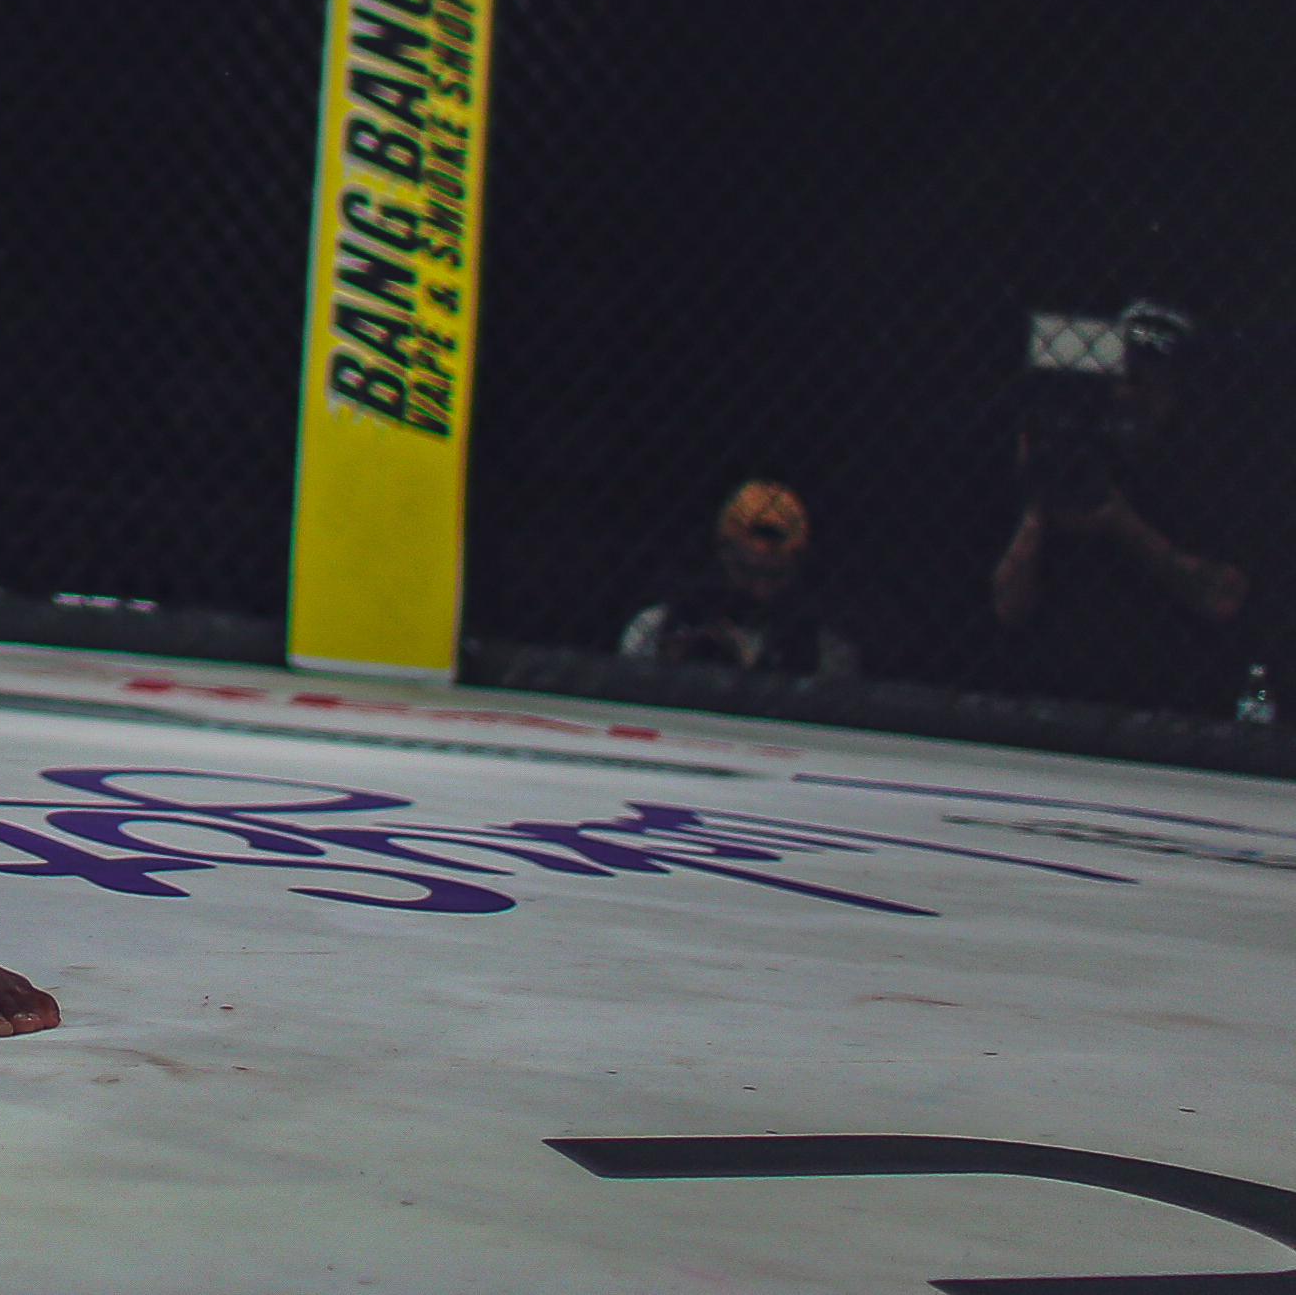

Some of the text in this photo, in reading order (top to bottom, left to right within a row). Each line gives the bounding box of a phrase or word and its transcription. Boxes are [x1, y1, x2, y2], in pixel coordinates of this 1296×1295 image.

[421, 106, 471, 269] SMOKE
[330, 190, 421, 423] BANG
[428, 285, 459, 314] &
[408, 324, 458, 437] VAPE
